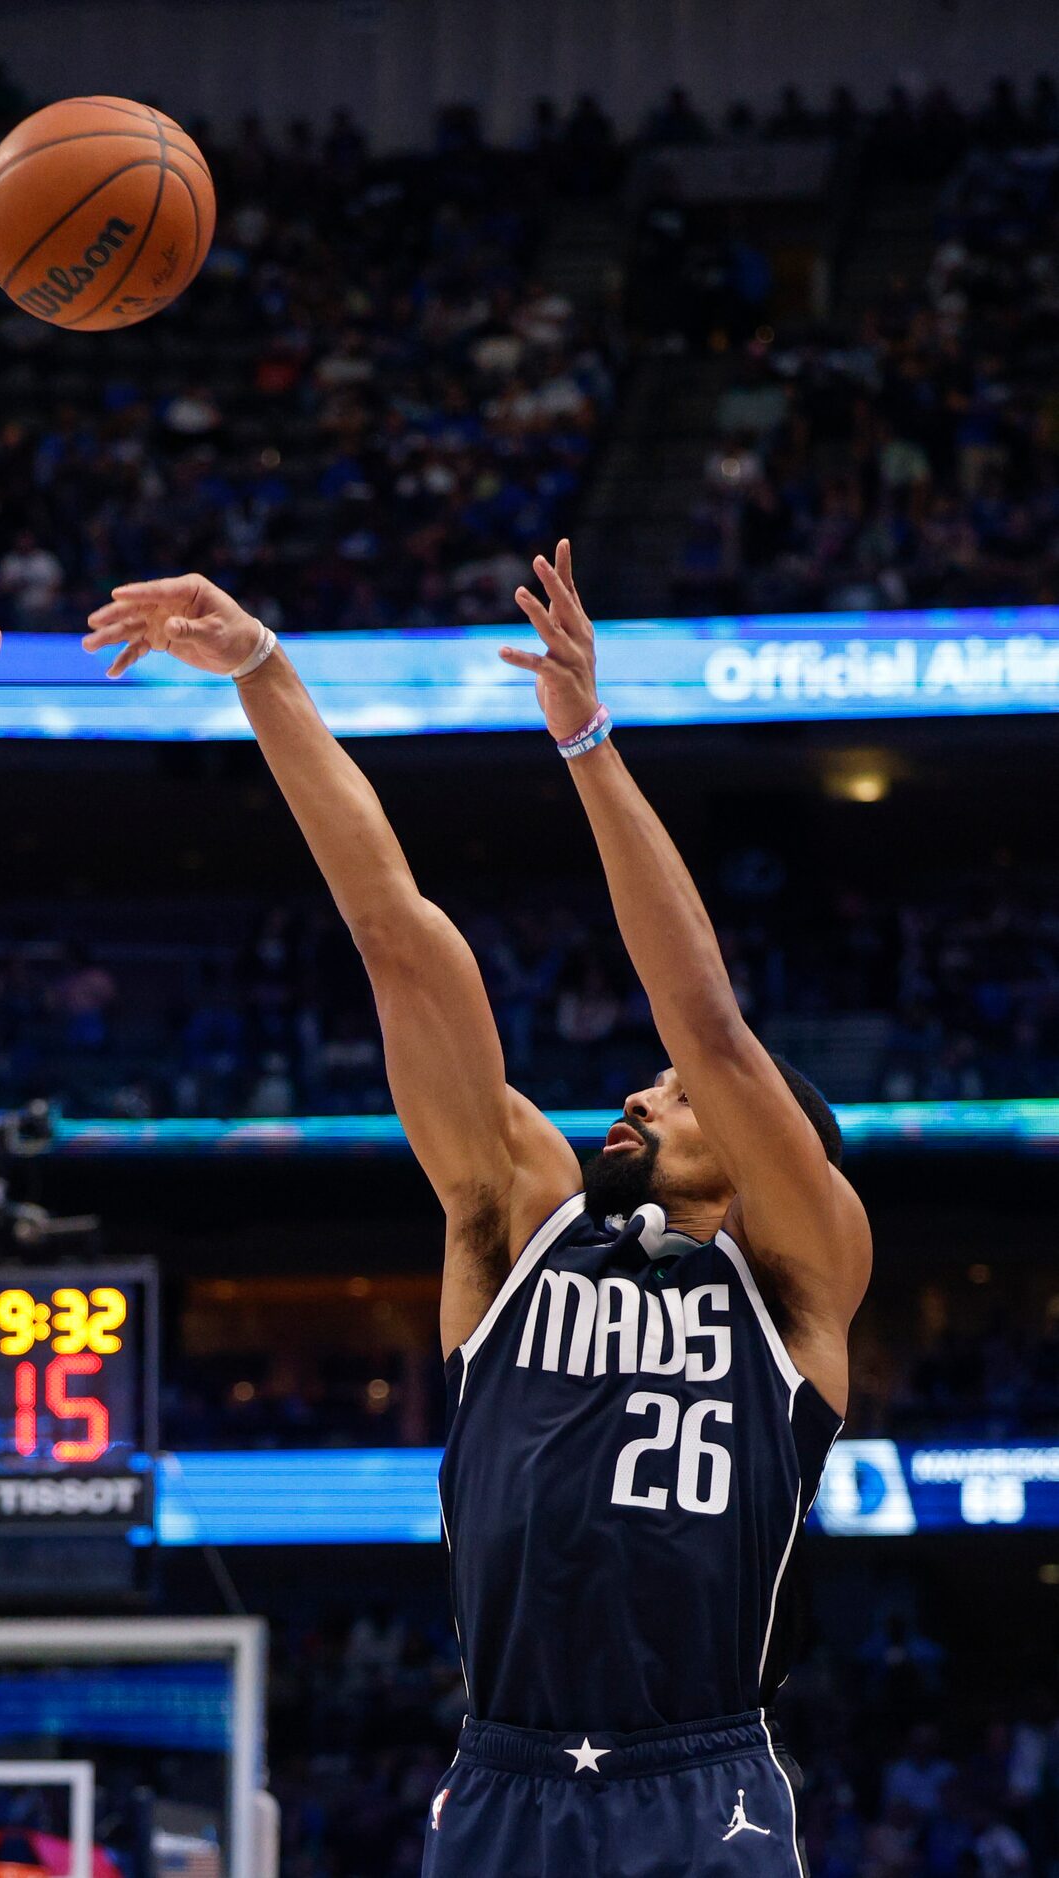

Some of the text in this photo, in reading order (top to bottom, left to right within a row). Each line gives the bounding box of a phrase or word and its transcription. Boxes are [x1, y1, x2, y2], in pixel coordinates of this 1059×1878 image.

[18, 215, 137, 318] Wilson
[705, 638, 918, 702] Official
[516, 1268, 732, 1382] MAVS
[15, 1353, 109, 1463] 15
[611, 1391, 733, 1515] 26
